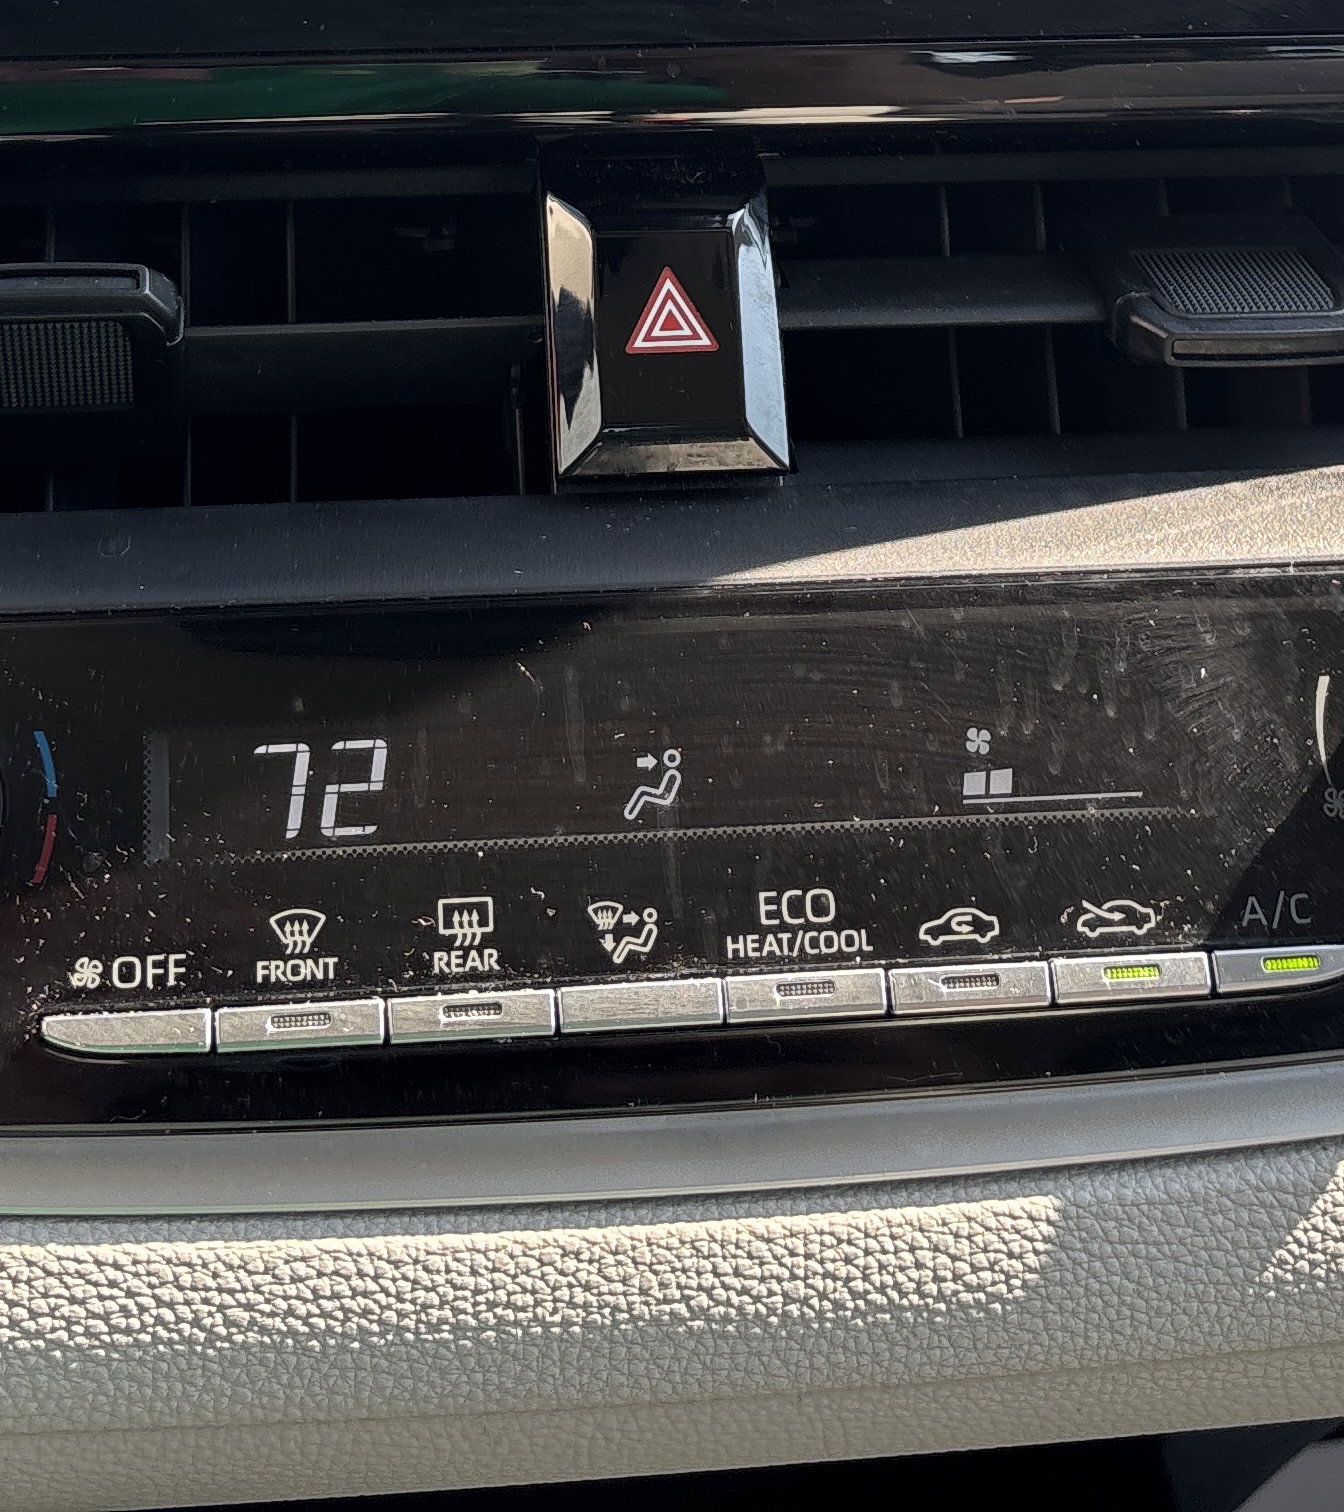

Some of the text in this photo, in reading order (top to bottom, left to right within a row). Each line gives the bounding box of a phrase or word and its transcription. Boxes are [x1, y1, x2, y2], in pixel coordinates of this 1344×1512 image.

[253, 738, 388, 839] 72
[758, 888, 836, 925] ECO
[1241, 890, 1312, 929] A/C
[431, 948, 499, 974] REAR
[726, 928, 875, 959] HEAT/COOL
[112, 953, 187, 991] OFF
[256, 956, 339, 984] FRONT
